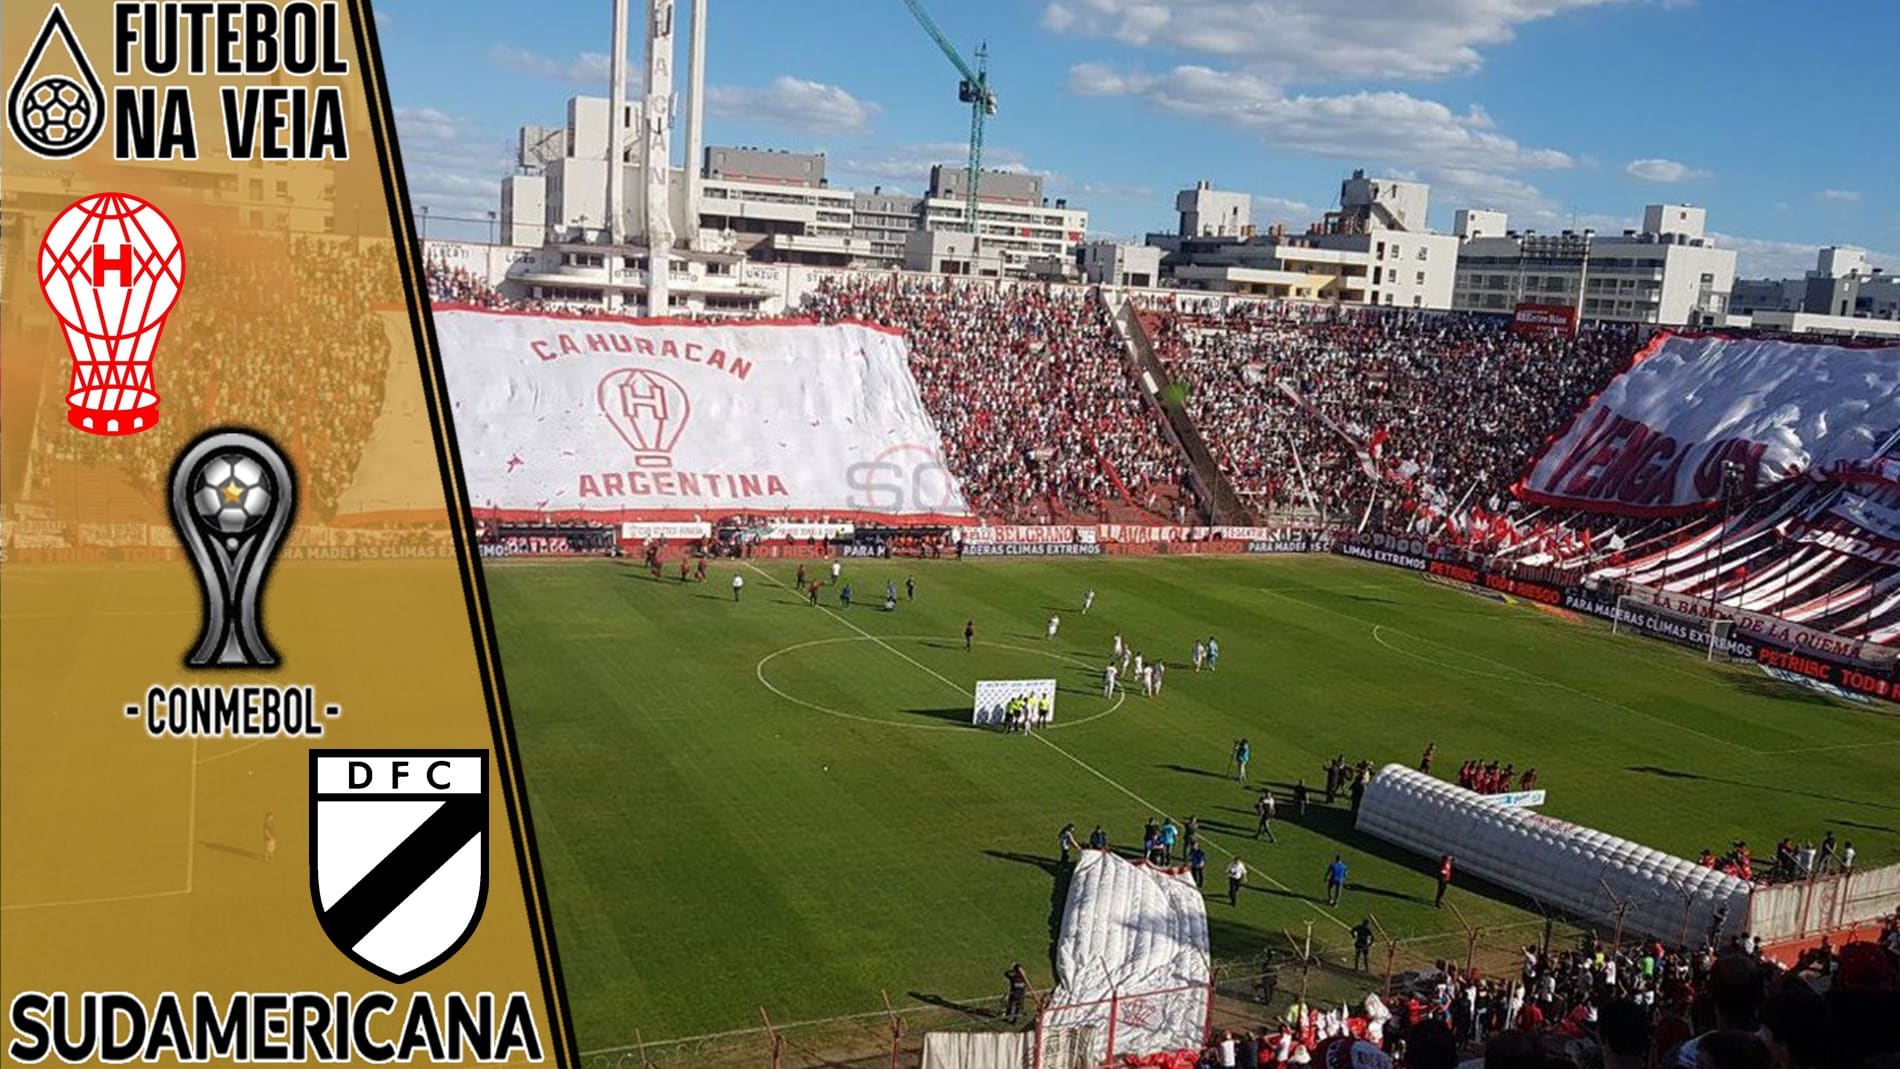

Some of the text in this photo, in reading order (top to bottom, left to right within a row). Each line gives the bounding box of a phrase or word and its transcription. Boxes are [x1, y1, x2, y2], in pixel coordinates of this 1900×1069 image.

[586, 333, 752, 380] HURACAN
[579, 472, 788, 498] ARGENTINA
[995, 526, 1073, 543] BELGRANO
[382, 546, 436, 558] CLIMAS
[843, 545, 875, 556] PARA
[961, 544, 1100, 555] ADERAS CLIMAS EXTREMOS
[1249, 541, 1273, 551] PARA
[1374, 550, 1426, 570] EXTREMOS
[1518, 582, 1561, 604] RIESGO
[1565, 596, 1753, 657] PARA MADERAS CLIMAS EXTREMOS
[1653, 597, 1673, 609] LA
[1740, 614, 1765, 634] DE
[1769, 621, 1790, 638] LA
